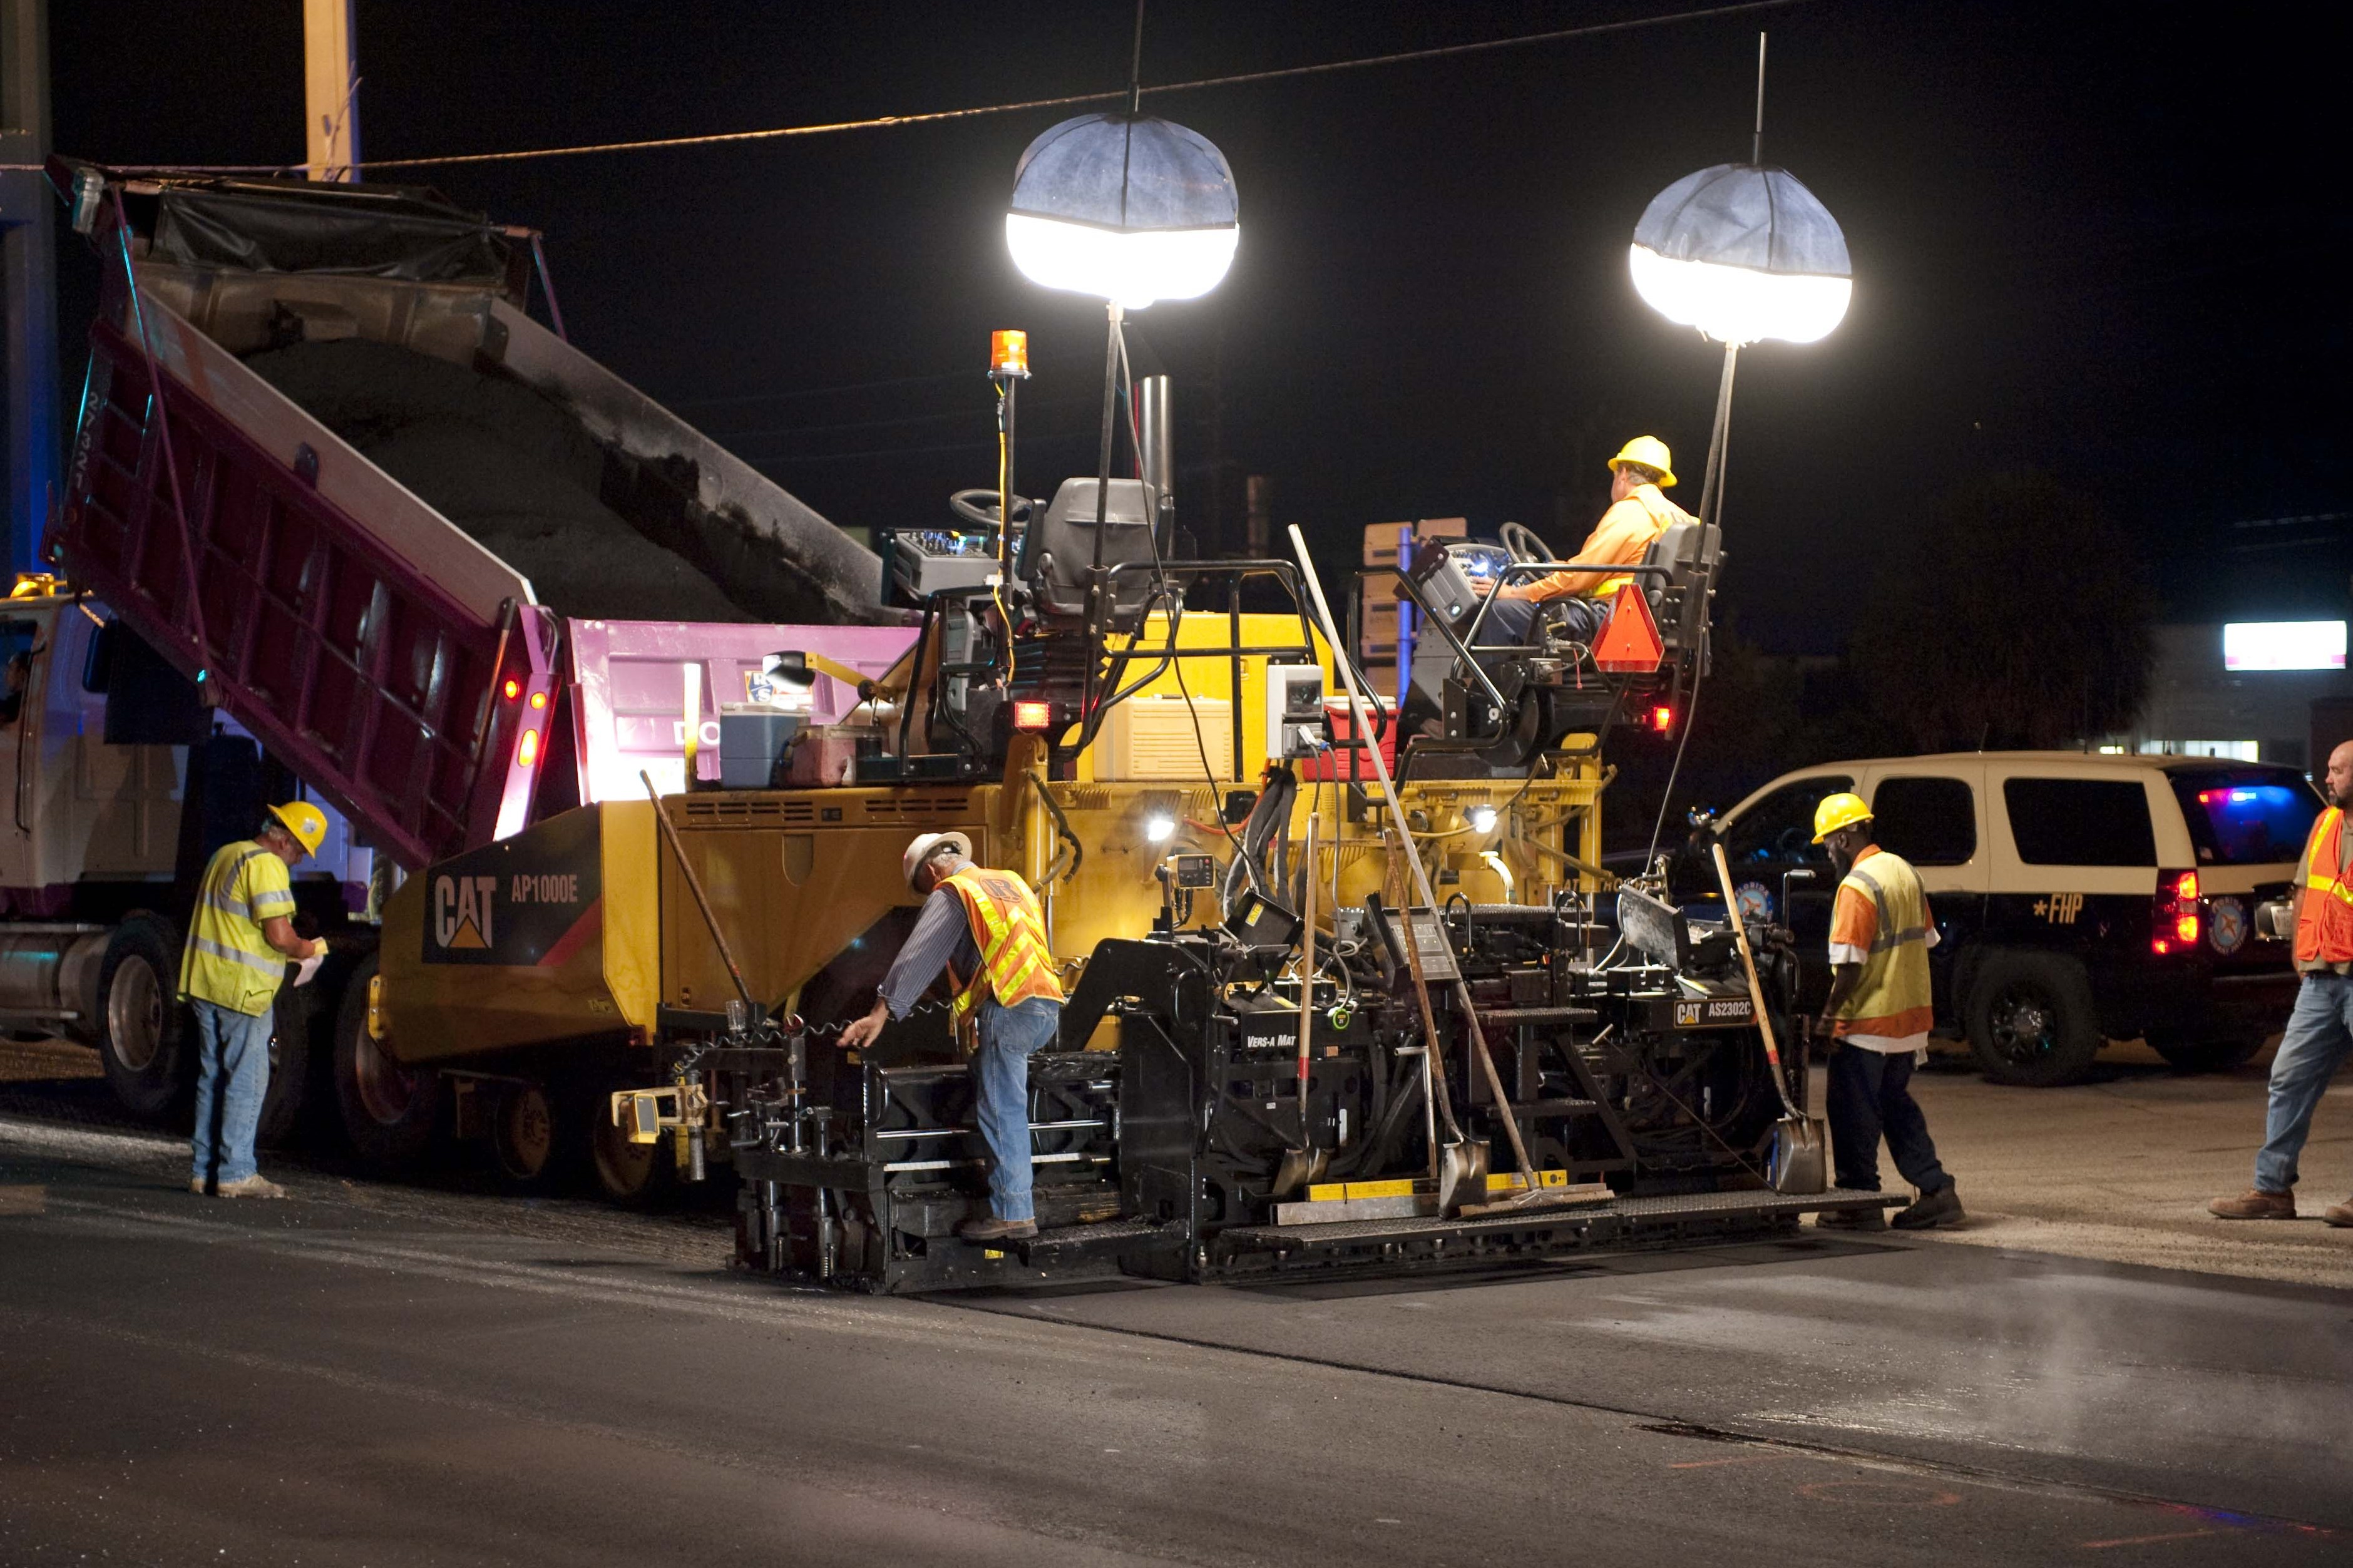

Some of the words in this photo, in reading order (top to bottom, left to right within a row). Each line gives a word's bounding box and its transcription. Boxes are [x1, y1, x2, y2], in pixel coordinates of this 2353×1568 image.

[75, 391, 99, 489] 27321
[434, 874, 497, 949] CAT
[511, 873, 578, 903] AP1000E
[1677, 1003, 1701, 1025] CAT
[1708, 1001, 1751, 1017] AS2302C
